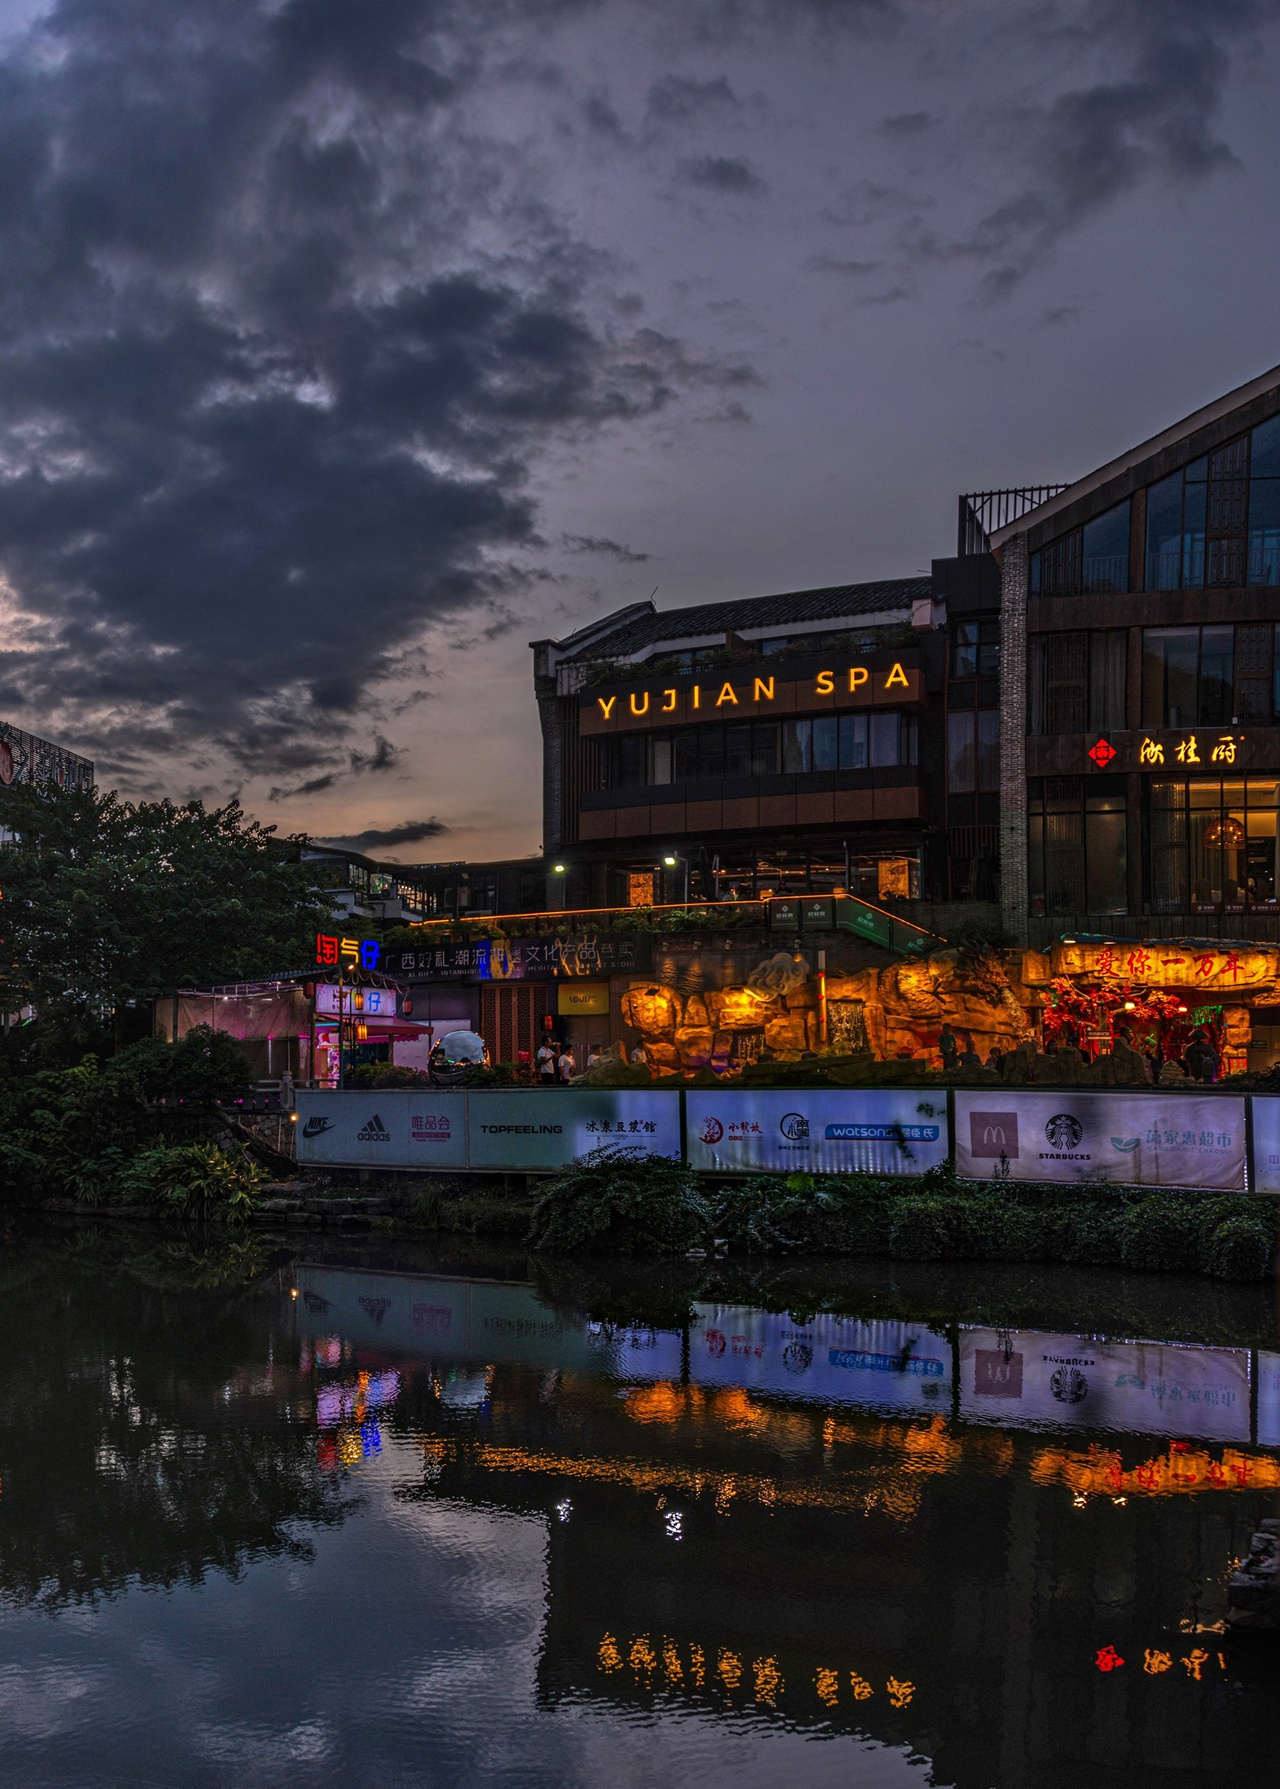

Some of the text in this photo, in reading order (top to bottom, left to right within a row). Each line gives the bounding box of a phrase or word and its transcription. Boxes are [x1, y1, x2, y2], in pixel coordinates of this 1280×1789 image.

[597, 662, 909, 720] YUJIAN SPA
[316, 933, 380, 970] 淘气仔
[1095, 947, 1245, 982] 爱你一万年
[307, 1116, 329, 1130] NIKE
[411, 1115, 451, 1130] 唯品会
[481, 1125, 563, 1134] TOPFEELING
[357, 1131, 391, 1142] adidas
[832, 1127, 893, 1137] watsons
[901, 1127, 934, 1138] 屈臣氏
